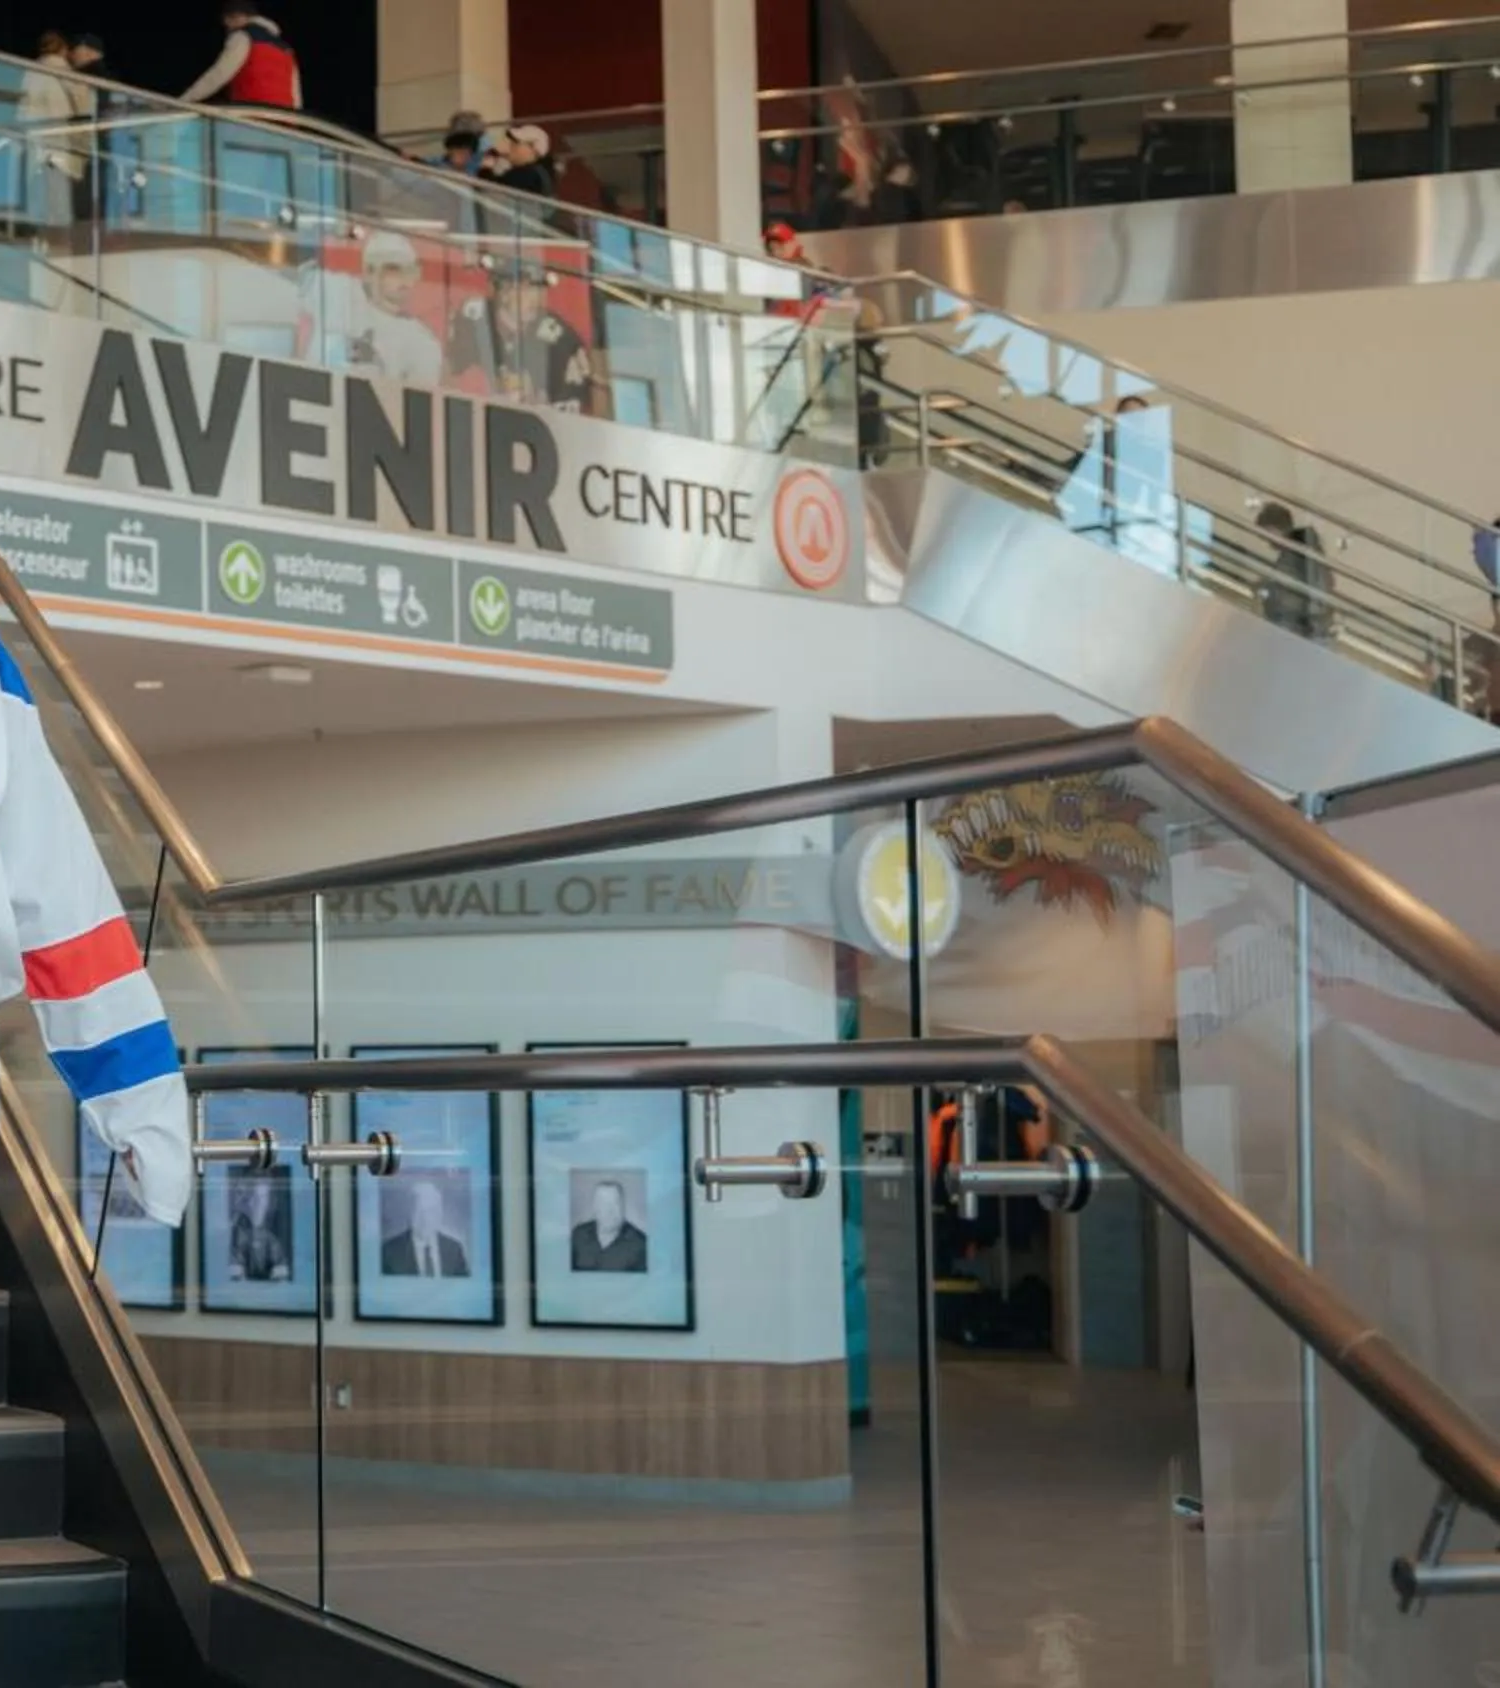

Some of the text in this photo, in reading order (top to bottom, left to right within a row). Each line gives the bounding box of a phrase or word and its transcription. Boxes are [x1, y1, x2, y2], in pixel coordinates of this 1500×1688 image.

[64, 328, 568, 553] AVENIR
[579, 464, 754, 543] CENTRE
[274, 552, 367, 586] washrooms
[275, 581, 345, 614] toilettes
[516, 587, 594, 616] arena floor
[516, 613, 579, 644] plancher
[580, 623, 599, 647] de
[410, 876, 542, 920] WALL
[556, 876, 627, 915] OF
[644, 868, 796, 914] FAME
